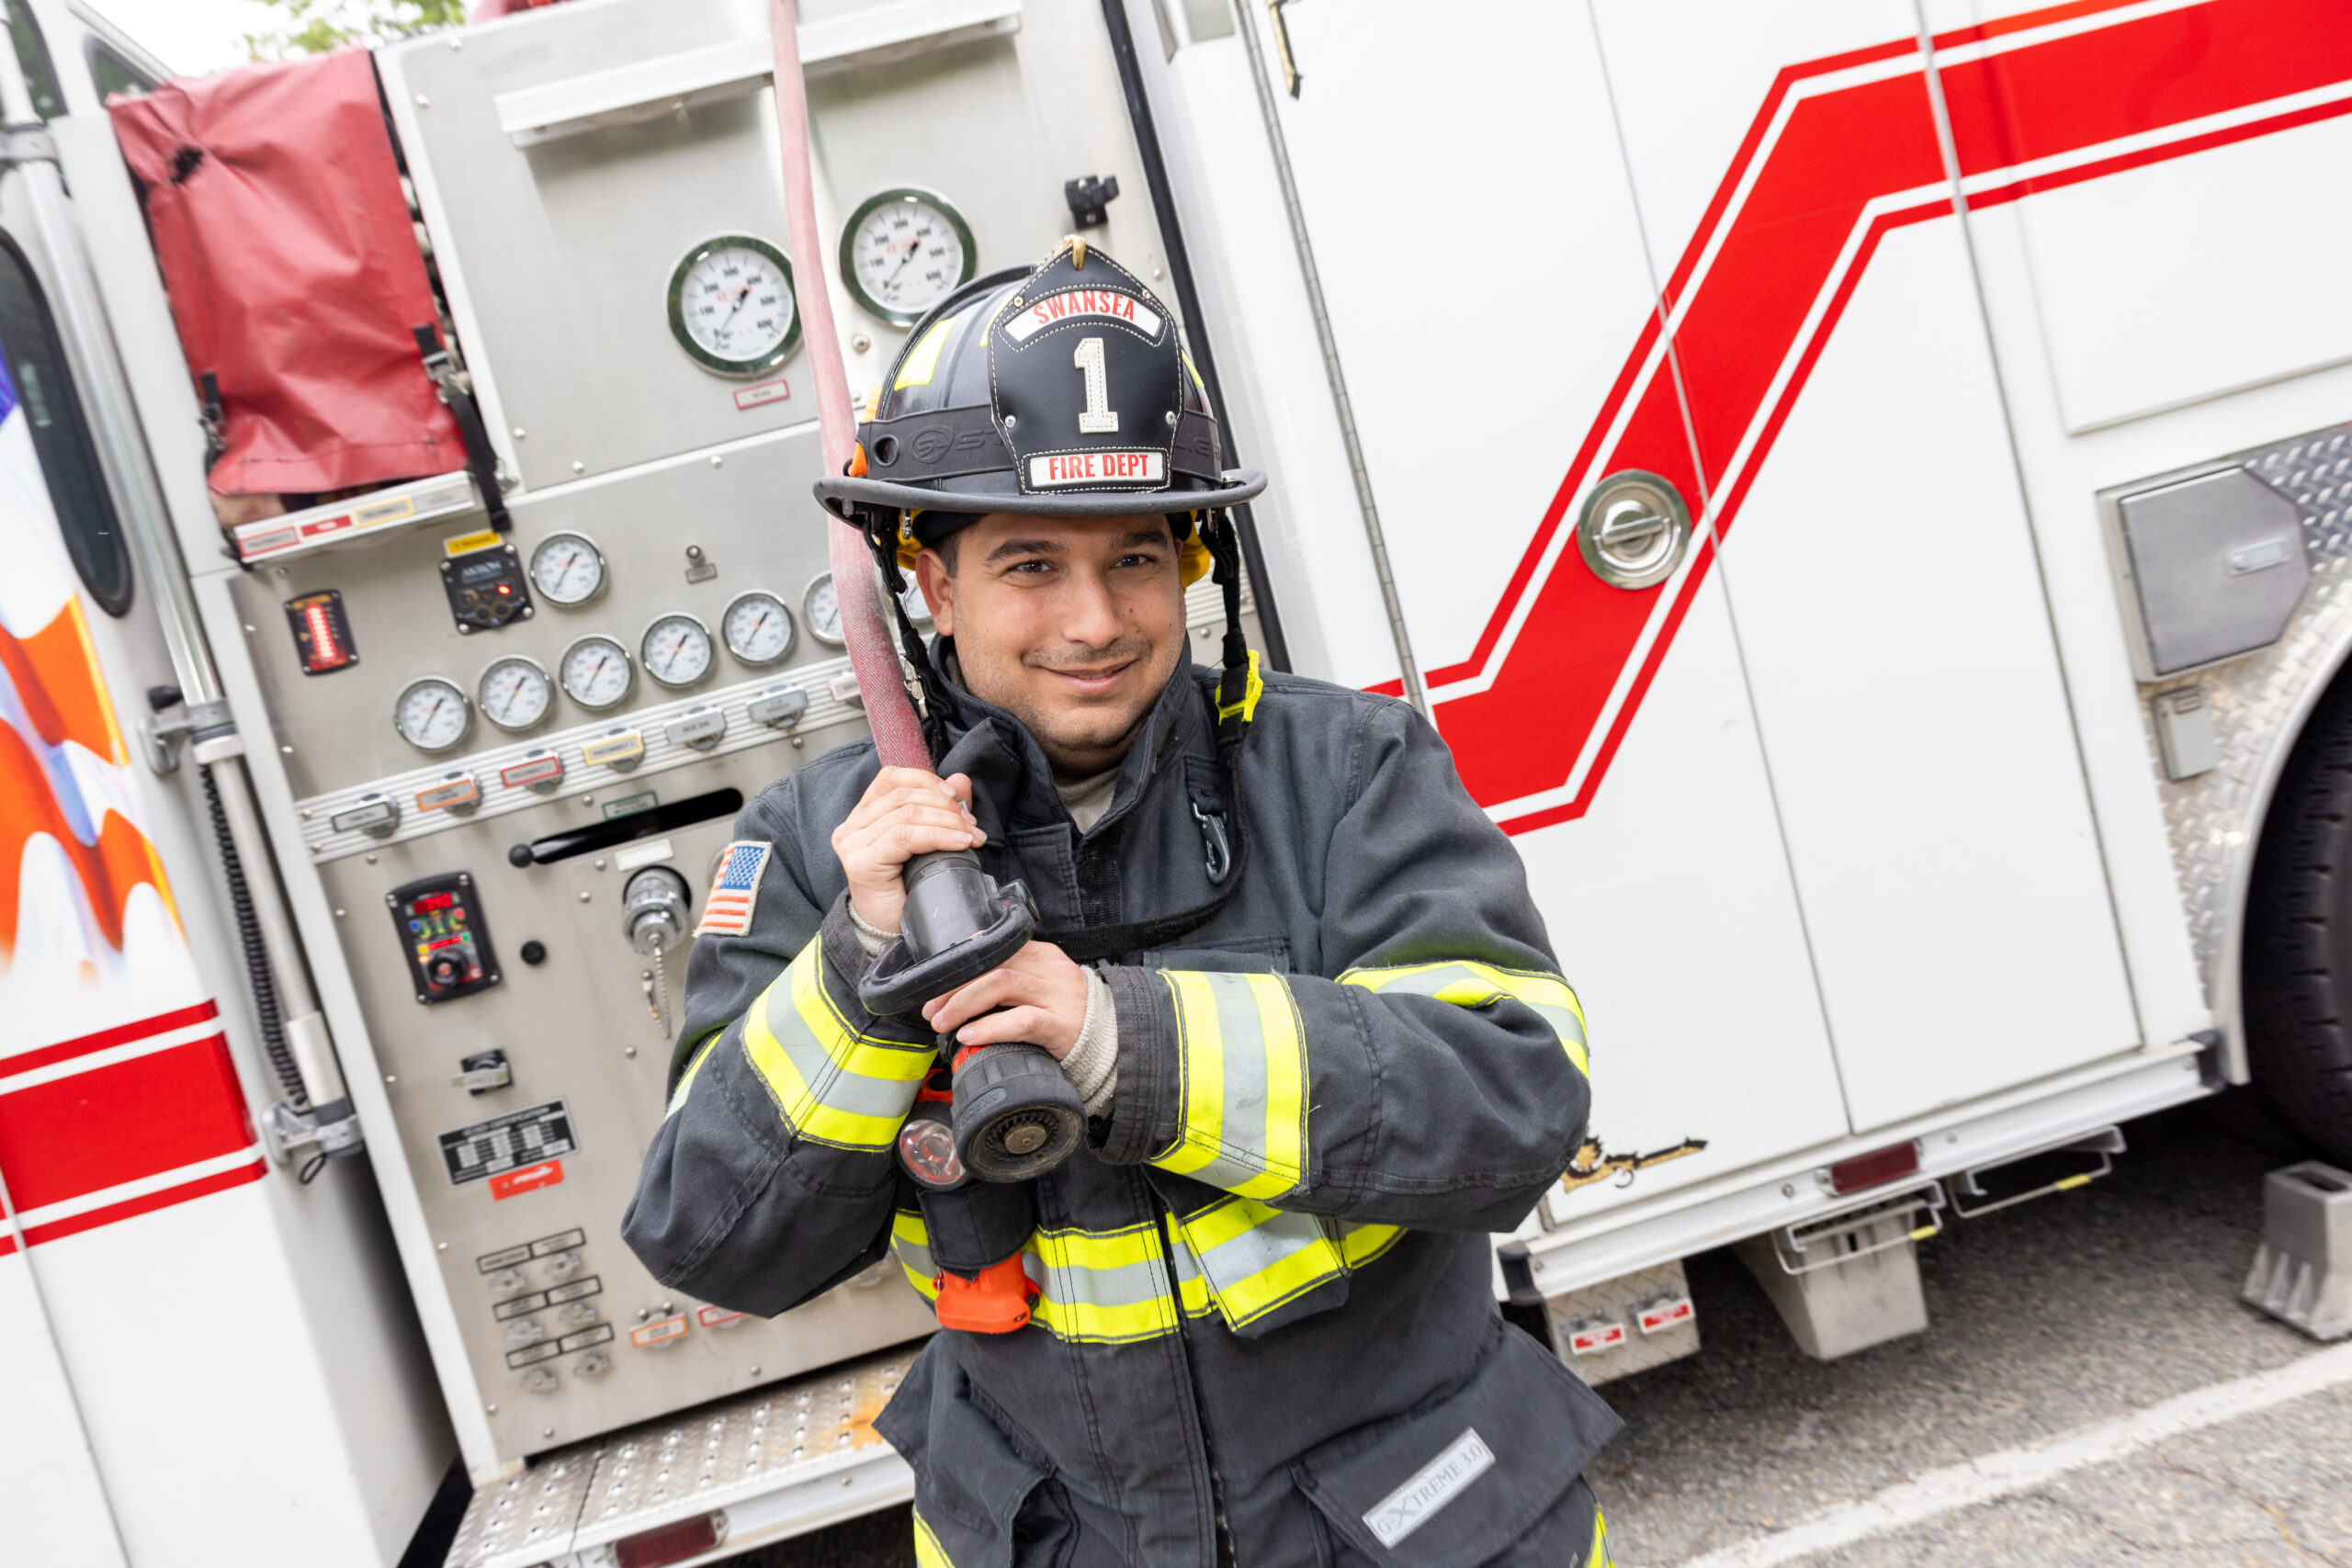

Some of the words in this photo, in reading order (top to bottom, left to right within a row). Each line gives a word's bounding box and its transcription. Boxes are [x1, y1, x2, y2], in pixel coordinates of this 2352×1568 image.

[1034, 290, 1135, 325] SWANSEA
[1074, 337, 1118, 434] 1
[1049, 455, 1096, 480] FIRE
[1102, 453, 1148, 478] DEPT
[1376, 1461, 1463, 1535] G-XTREME
[1460, 1442, 1483, 1469] 3.0
